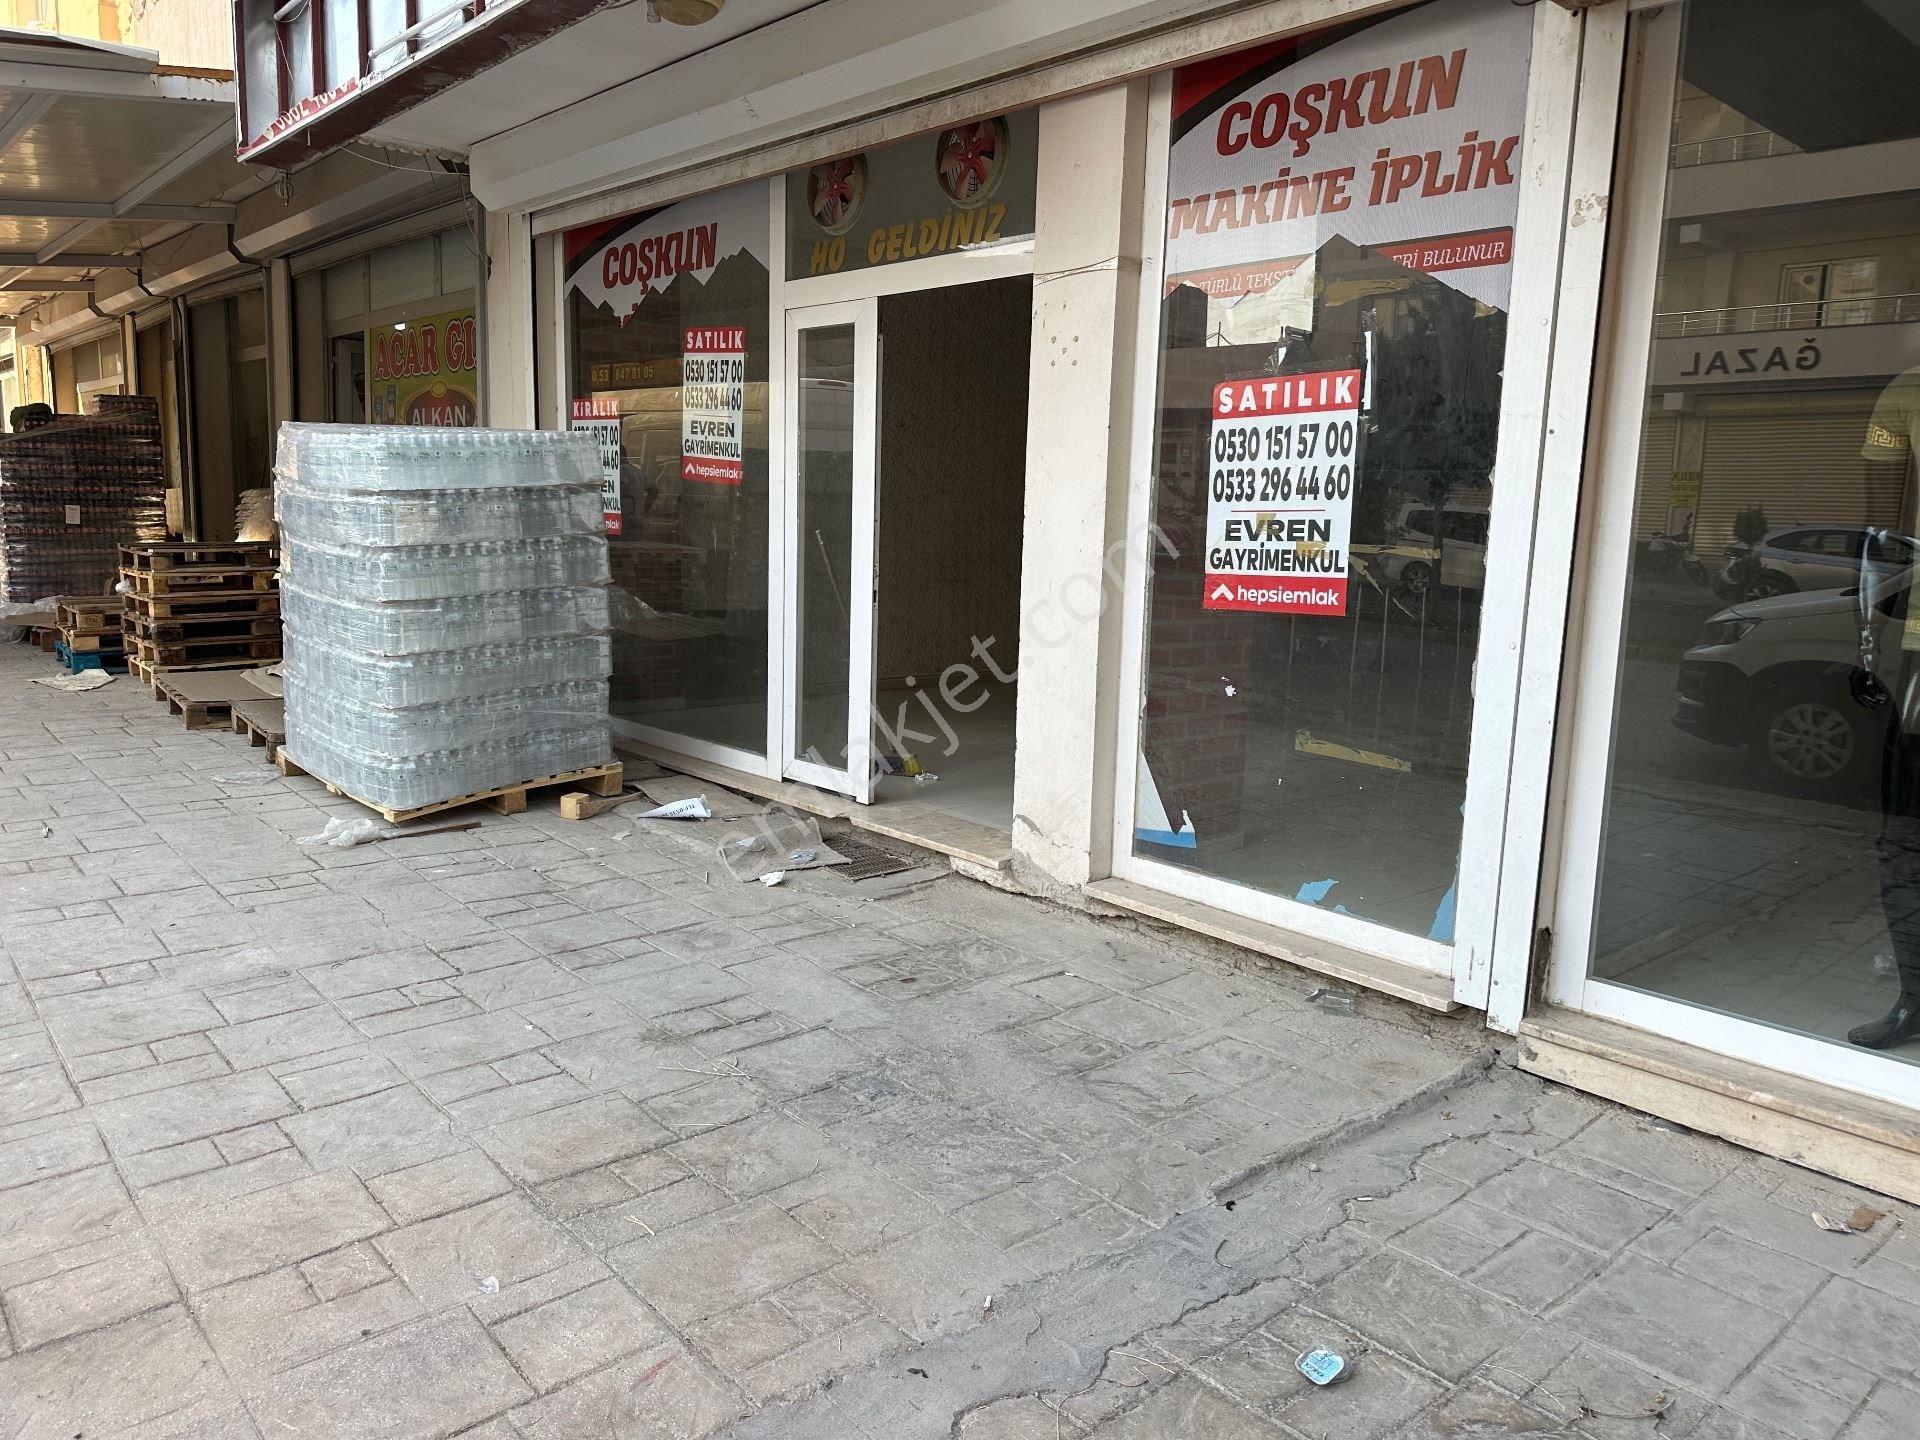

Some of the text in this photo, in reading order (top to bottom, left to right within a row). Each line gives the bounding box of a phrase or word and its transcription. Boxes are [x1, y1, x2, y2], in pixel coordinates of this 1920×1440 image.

[1216, 49, 1467, 157] COŞKUN
[1169, 130, 1519, 239] MAKİNE İPLİK
[602, 222, 718, 296] COŞKUN
[1200, 275, 1242, 293] TÜRLÜ
[1423, 241, 1505, 267] BULUNUR
[373, 317, 478, 381] ACAR GI
[686, 330, 743, 350] SATILIK
[685, 360, 743, 383] 0530 151 57 00
[685, 385, 742, 411] 0533 296 44 60
[1218, 375, 1354, 414] SATILIK
[411, 405, 467, 427] ALKAN
[601, 425, 609, 446] 57
[609, 425, 619, 446] 00
[690, 421, 735, 438] EVREN
[1214, 420, 1353, 463] 0530 151 57 00
[684, 435, 741, 459] GAYRİMENKUL
[610, 450, 619, 471] 60
[695, 463, 740, 480] hepsiemlak
[1212, 464, 1351, 503] 0533 296 44 60
[1224, 519, 1332, 543] EVREN
[1209, 542, 1346, 574] GAYRİMENKUL
[1237, 584, 1340, 606] hepsiemlak
